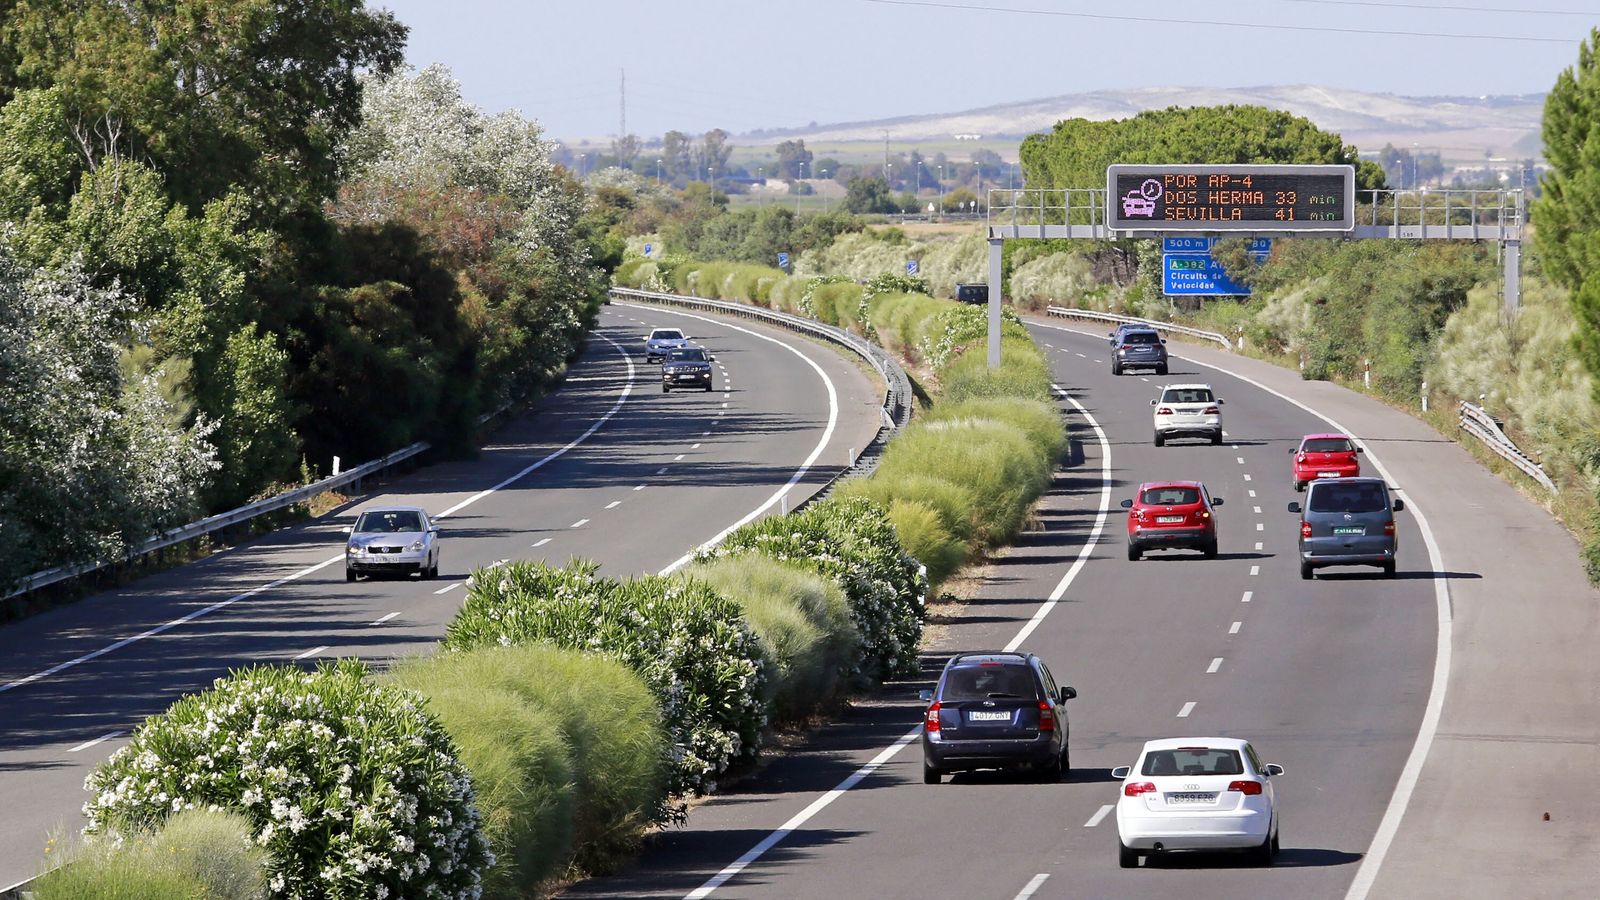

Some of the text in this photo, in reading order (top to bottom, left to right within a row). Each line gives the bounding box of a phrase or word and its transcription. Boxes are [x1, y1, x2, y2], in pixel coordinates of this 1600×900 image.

[1164, 174, 1252, 188] POR AP-4
[1164, 191, 1335, 204] DOS HERMA 33 min
[1164, 207, 1335, 221] SEVILLA 41 min
[1169, 239, 1191, 247] 500
[1171, 260, 1205, 269] A-382
[1170, 272, 1222, 280] Circuito de
